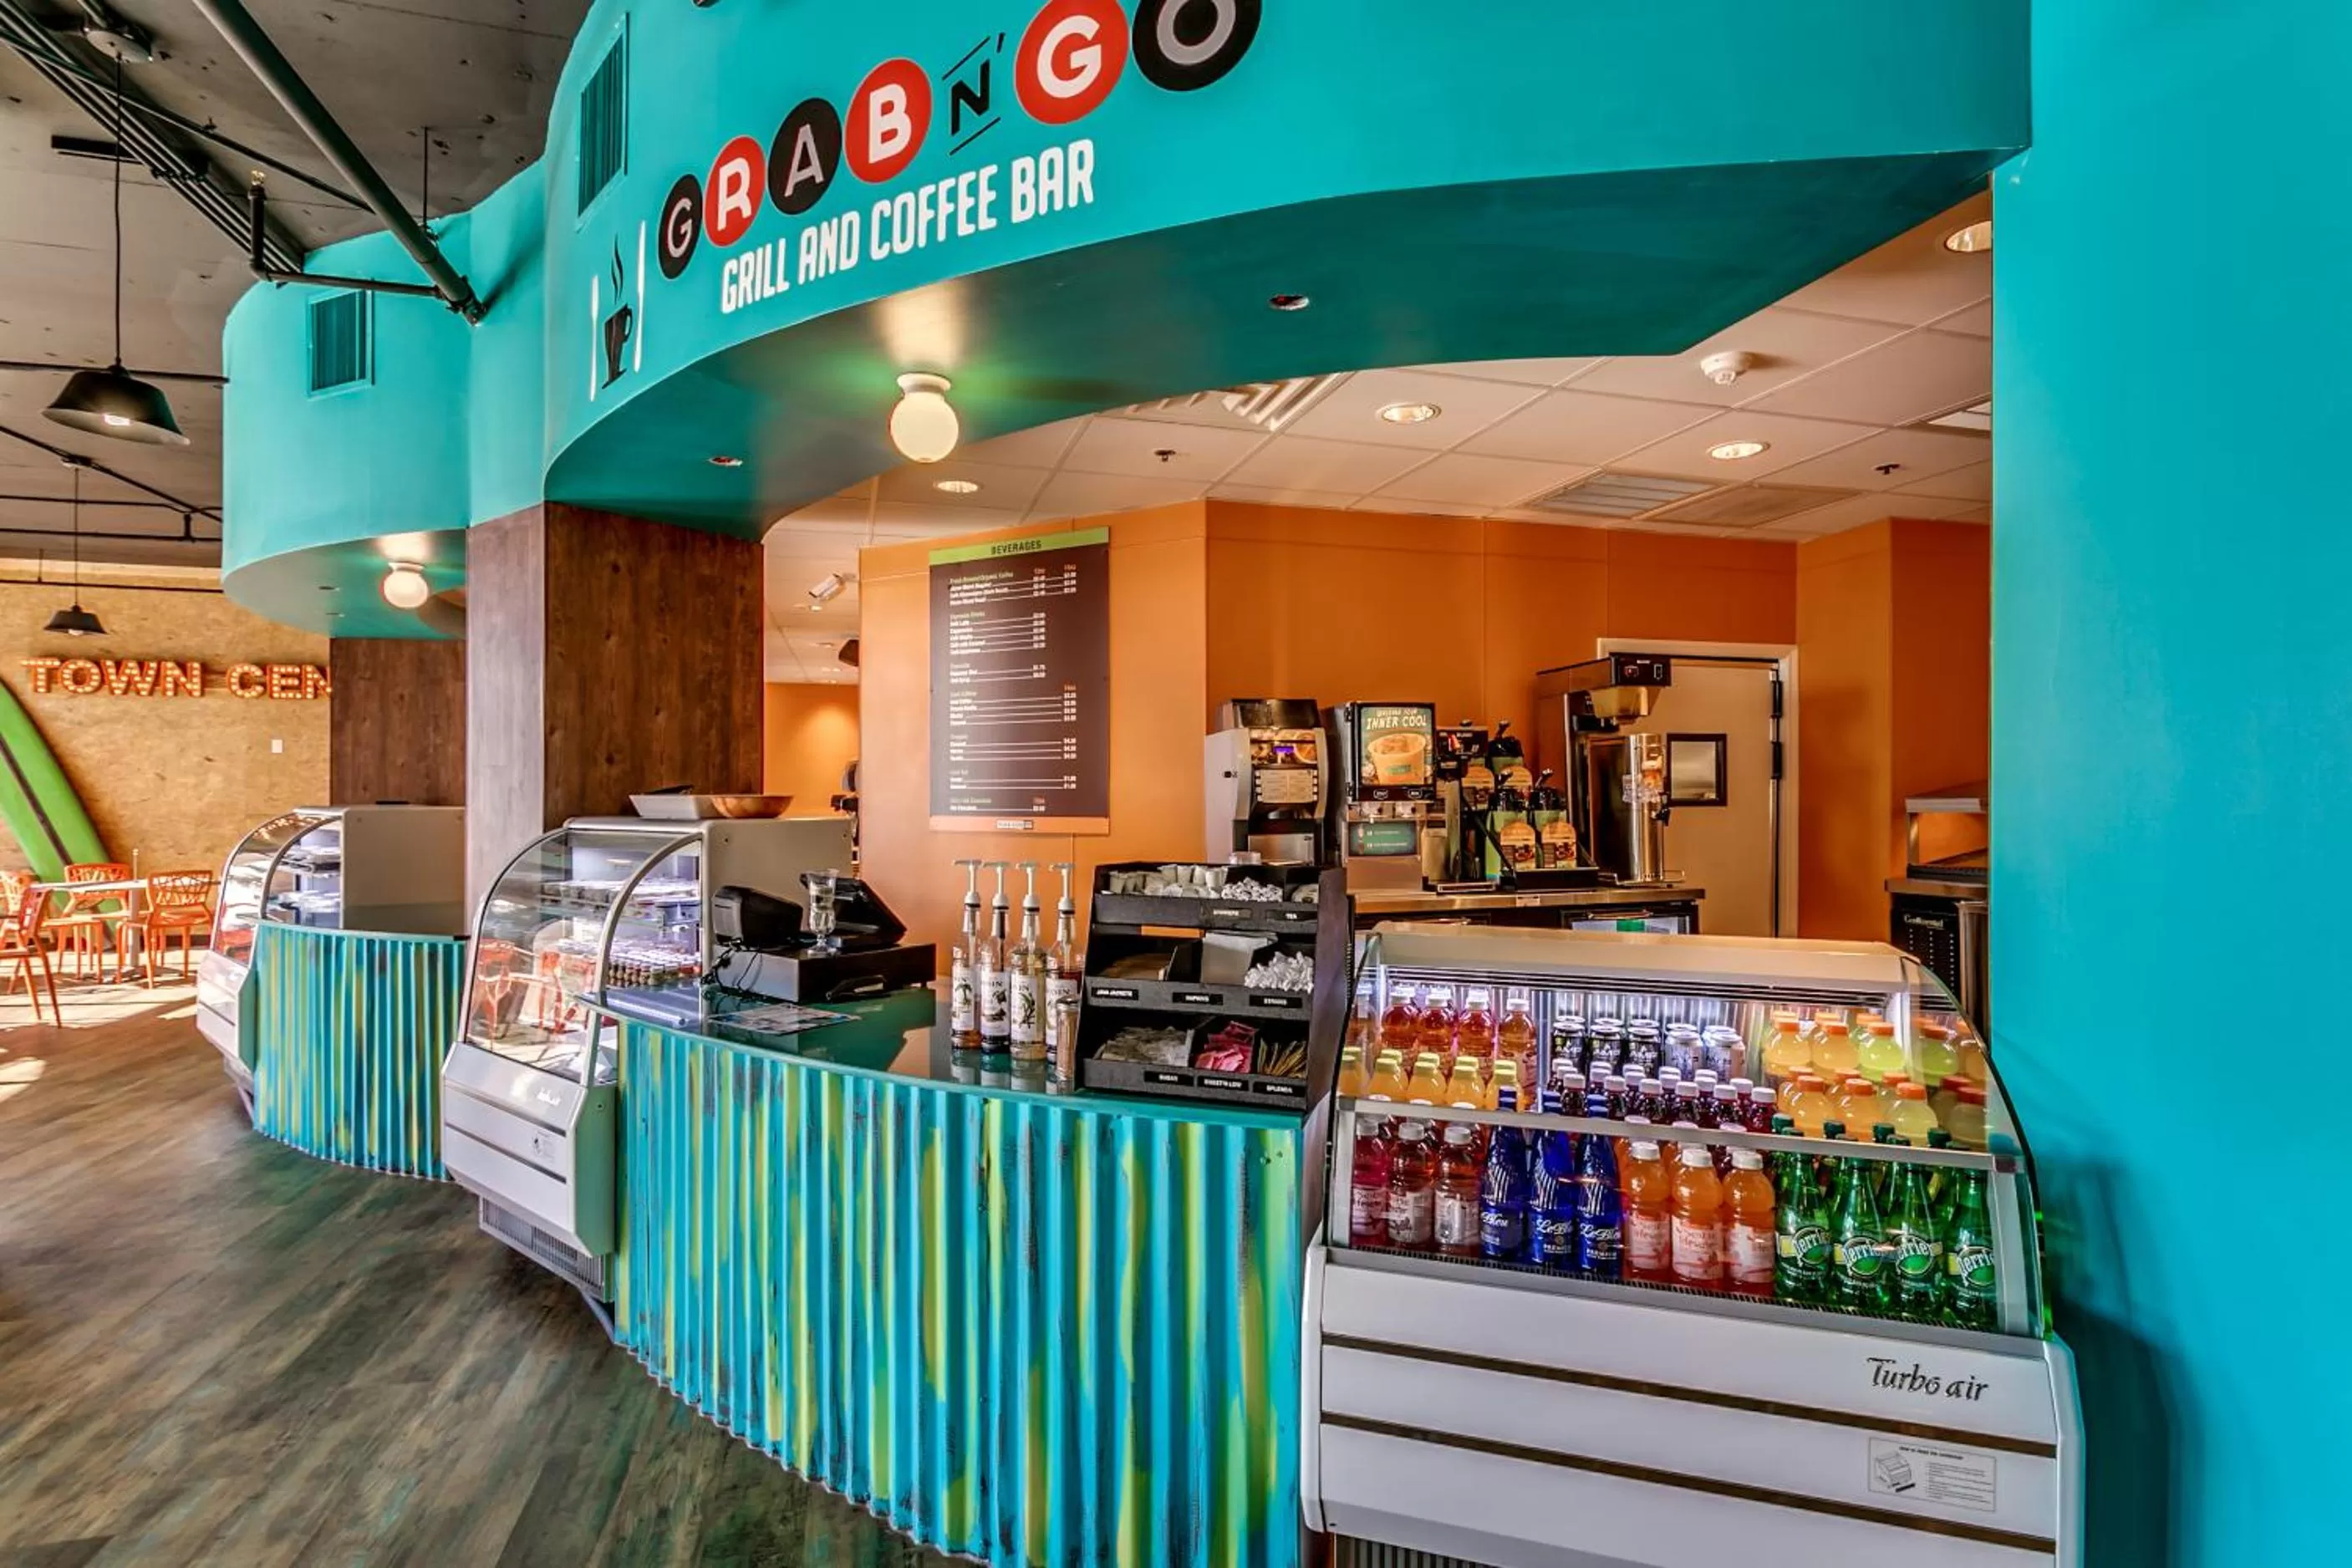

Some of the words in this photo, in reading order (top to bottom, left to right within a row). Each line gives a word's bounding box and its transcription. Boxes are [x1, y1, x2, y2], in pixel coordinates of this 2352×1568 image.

[668, 83, 912, 259] GRAB
[1036, 0, 1237, 99] GO
[720, 237, 789, 314] GRILL
[798, 209, 859, 284] AND
[870, 164, 998, 260] COFFEE
[1011, 139, 1094, 224] BAR
[991, 539, 1042, 555] BEVERAGES
[20, 658, 204, 697] TOWN
[1367, 716, 1399, 730] INNER
[1945, 1375, 1989, 1401] air
